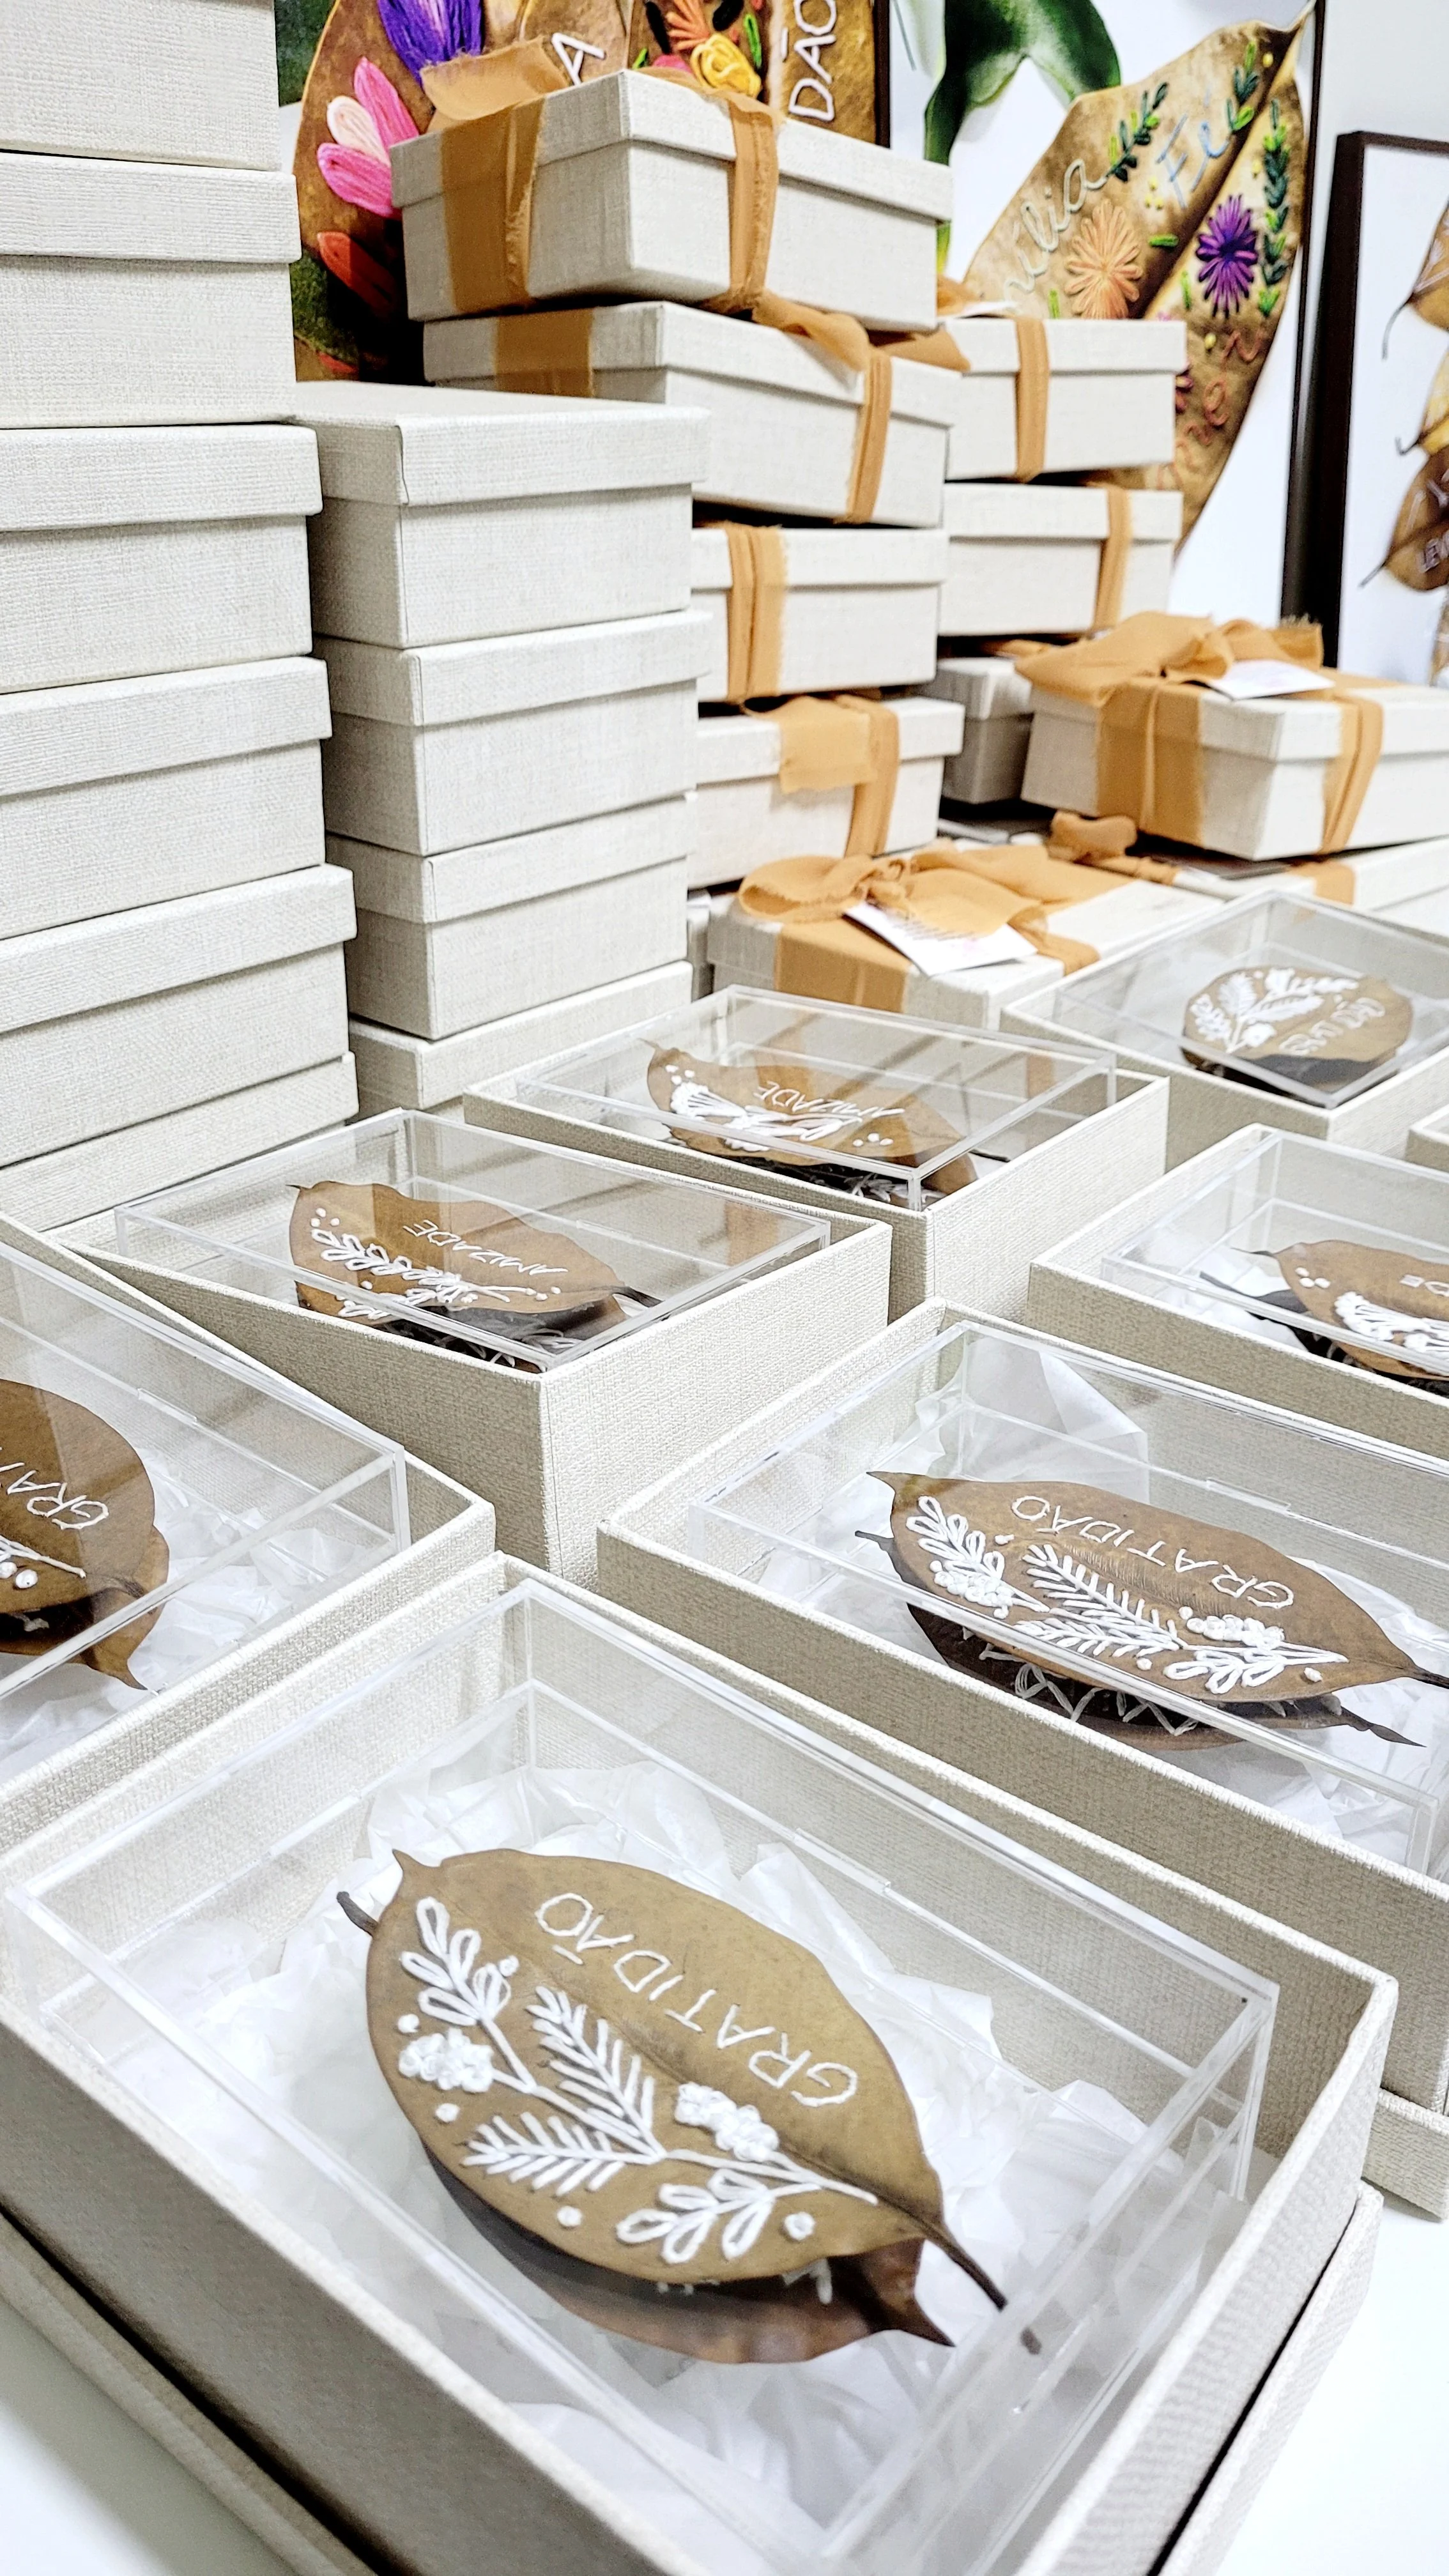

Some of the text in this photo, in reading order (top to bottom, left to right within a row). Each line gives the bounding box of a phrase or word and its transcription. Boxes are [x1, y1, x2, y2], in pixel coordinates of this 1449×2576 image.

[753, 1080, 906, 1117] AMIZADE
[402, 1218, 569, 1276] AMIZADE
[1011, 1495, 1295, 1609] GRATIDÃO
[533, 1892, 859, 2108] GRATIDÃO
